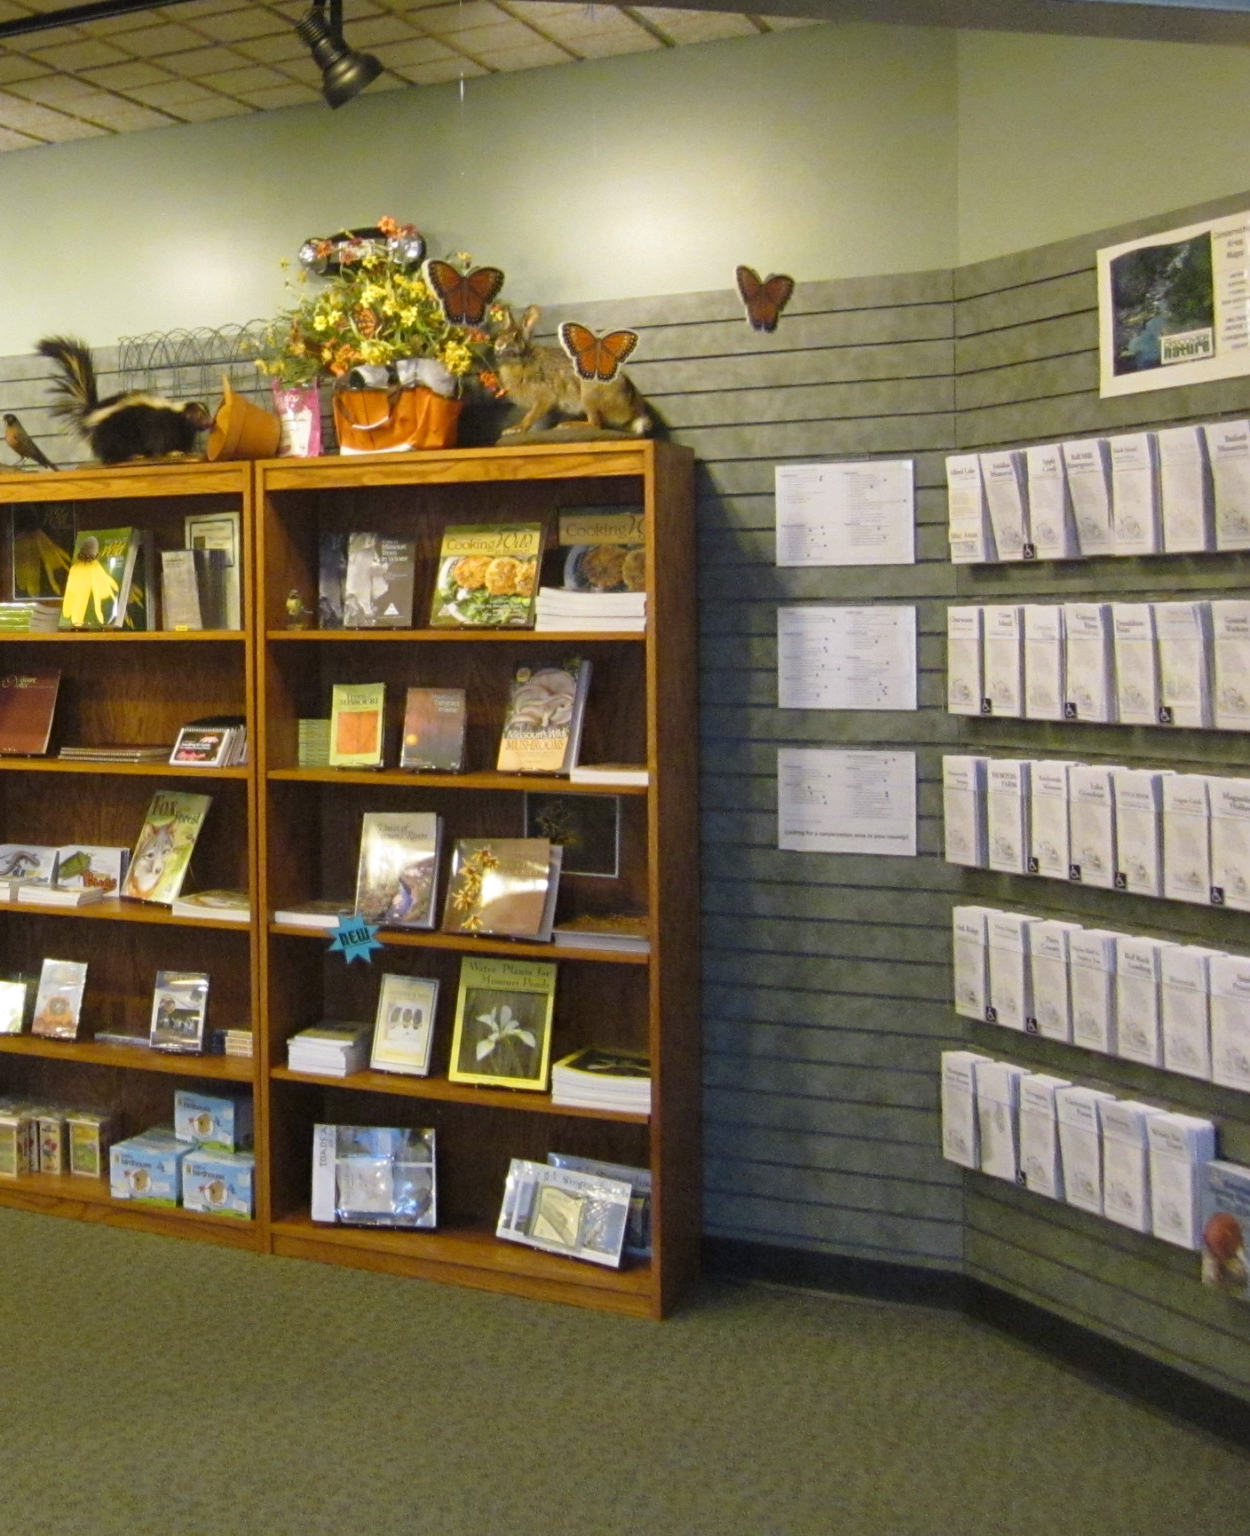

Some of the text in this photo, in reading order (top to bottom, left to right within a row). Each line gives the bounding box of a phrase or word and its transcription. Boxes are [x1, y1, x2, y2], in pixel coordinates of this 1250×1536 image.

[1164, 341, 1210, 359] nature
[566, 521, 627, 538] Cooking
[447, 537, 495, 552] Cooking
[505, 739, 564, 750] MUSHROOMS
[84, 871, 118, 888] Bugs
[338, 927, 370, 946] NEW
[469, 962, 496, 974] Water
[501, 964, 533, 977] Plants
[481, 974, 551, 989] Missouri Ponds
